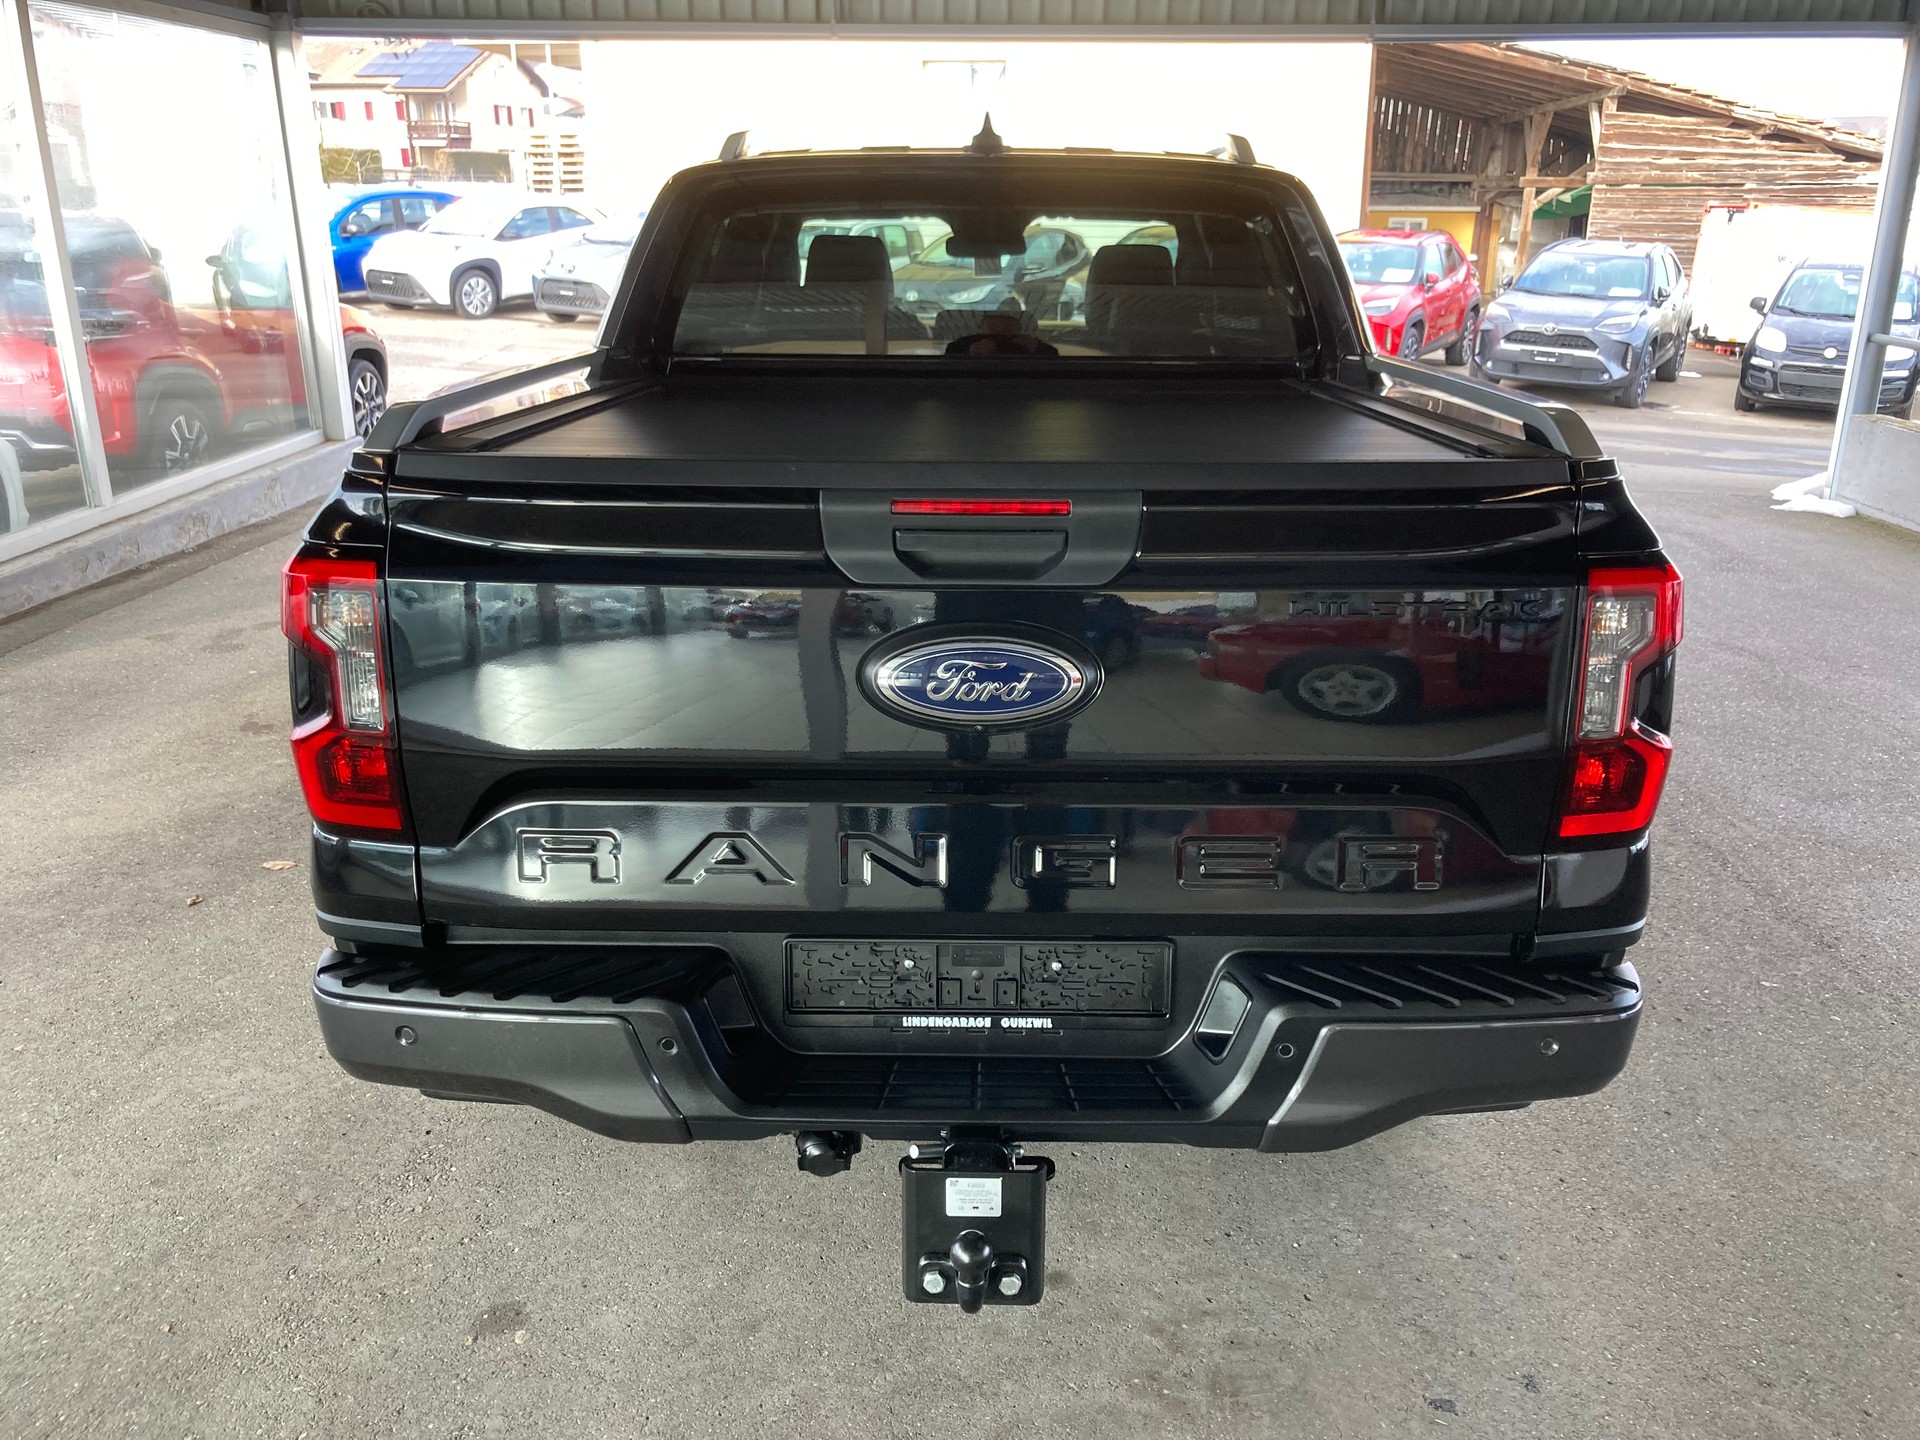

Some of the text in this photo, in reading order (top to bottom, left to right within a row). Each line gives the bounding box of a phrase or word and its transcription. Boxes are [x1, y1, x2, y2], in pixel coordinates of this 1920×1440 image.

[926, 659, 1037, 702] Ford
[515, 827, 1444, 891] RANGER
[902, 1016, 1053, 1029] LINDENGARAGE GUNZWIL
